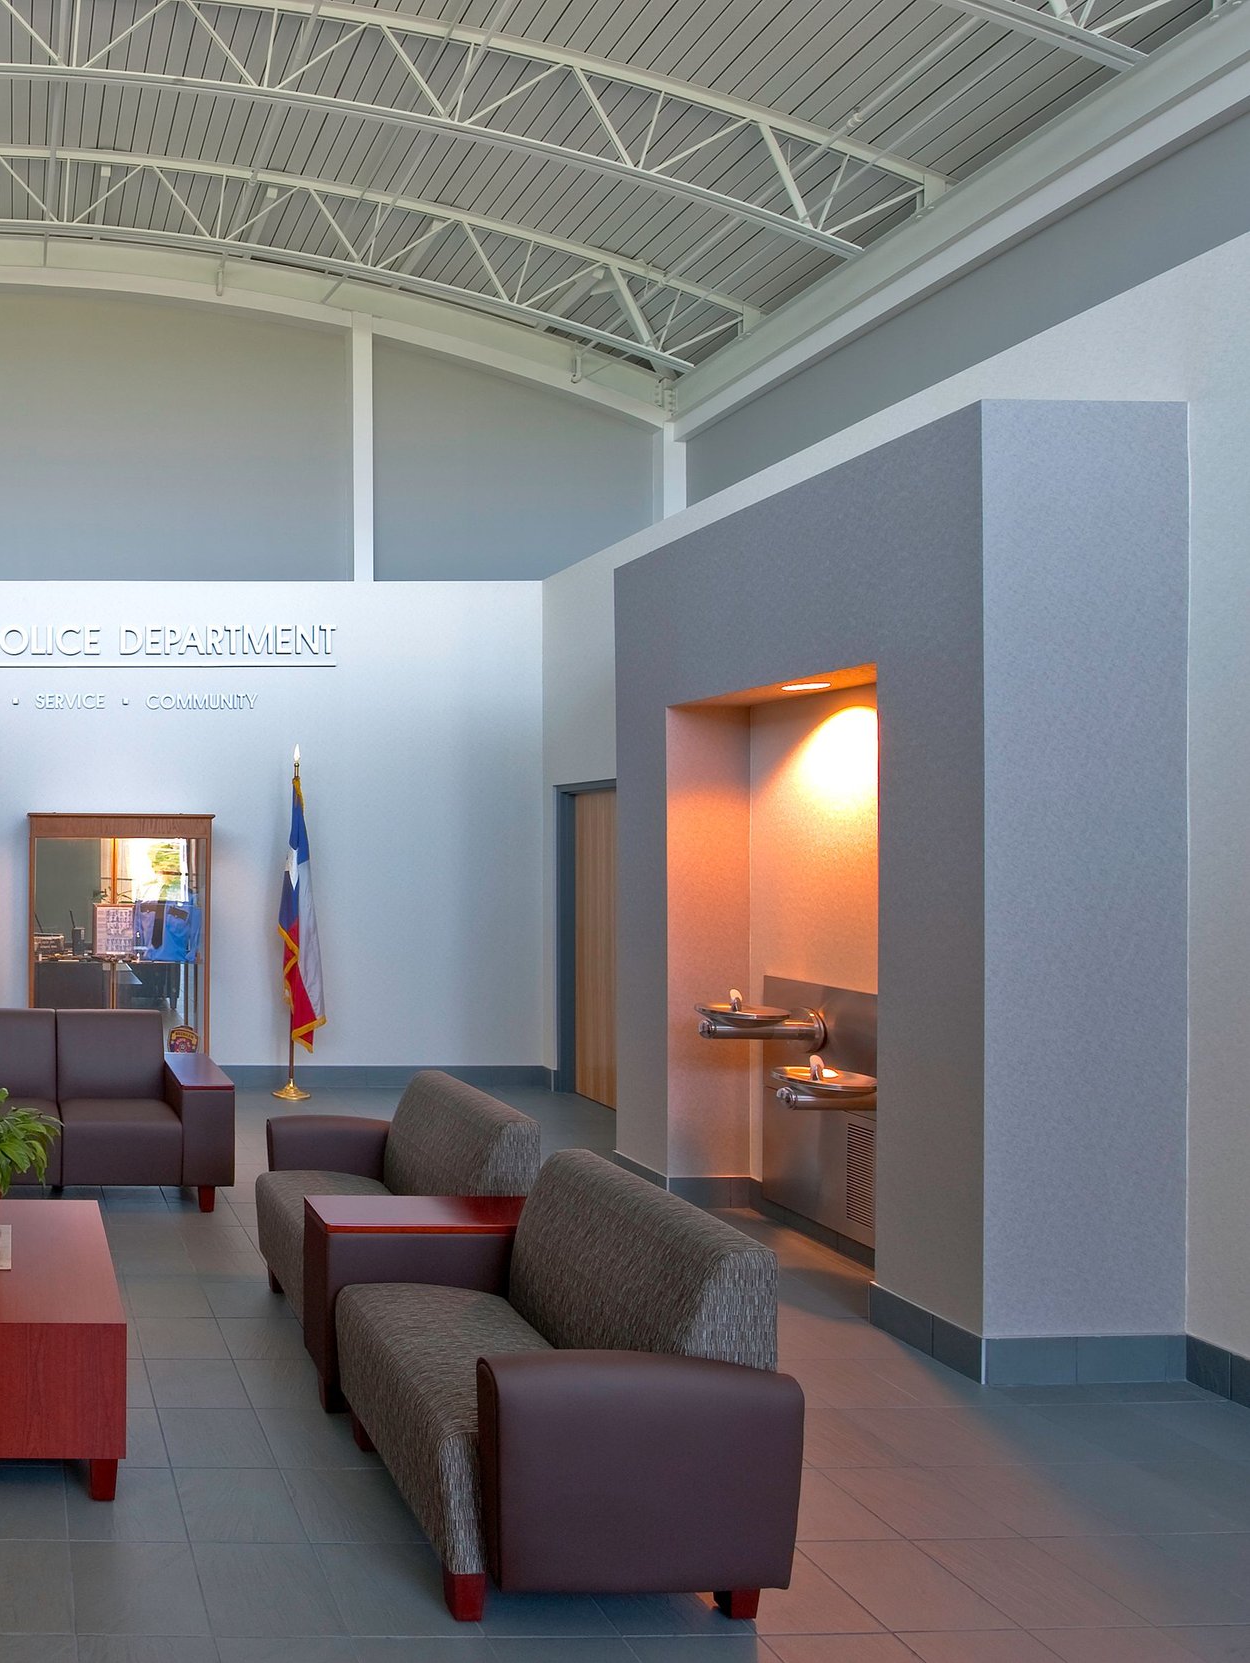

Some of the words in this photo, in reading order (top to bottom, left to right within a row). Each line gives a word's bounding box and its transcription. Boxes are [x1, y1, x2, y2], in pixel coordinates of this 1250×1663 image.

[118, 624, 338, 656] DEPARTMENT
[34, 692, 106, 710] SERVICE
[145, 692, 259, 710] COMMUNITY
